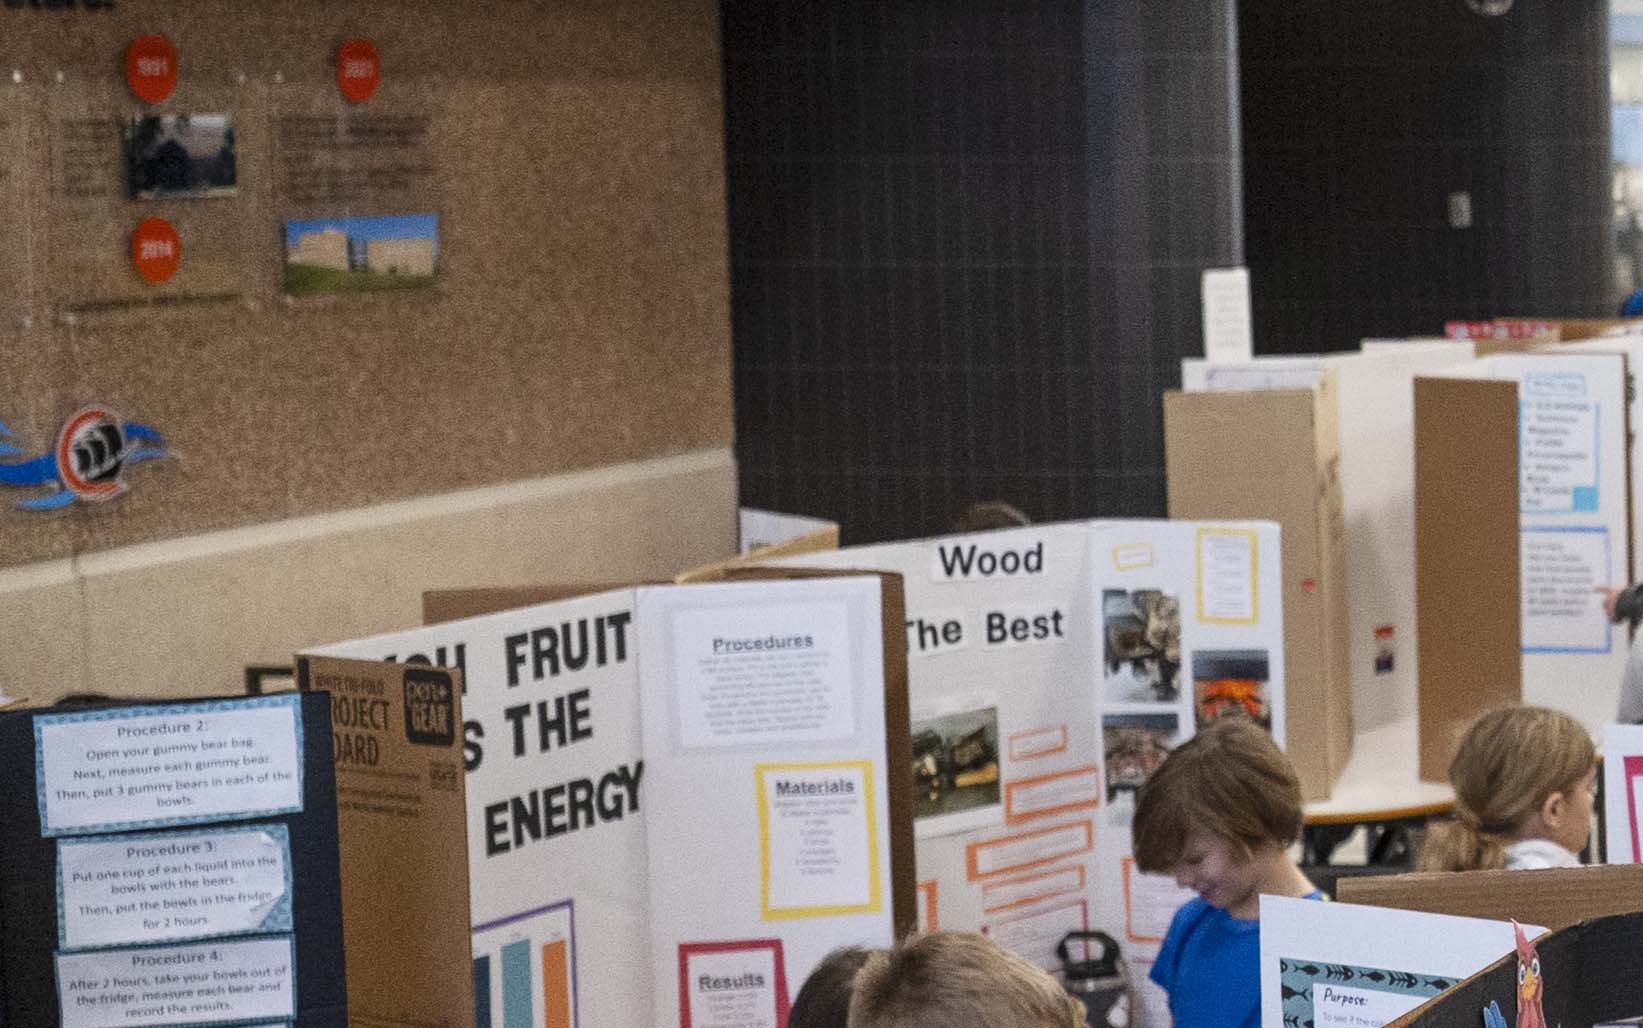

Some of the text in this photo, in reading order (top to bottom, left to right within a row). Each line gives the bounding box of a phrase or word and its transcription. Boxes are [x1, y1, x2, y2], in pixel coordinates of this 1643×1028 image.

[938, 542, 1044, 577] Wood
[986, 609, 1064, 644] Best
[505, 611, 631, 687] FRUIT
[712, 635, 813, 654] Procedures
[333, 698, 390, 732] ROJECT
[505, 689, 593, 758] THE
[775, 779, 854, 796] Materials
[484, 760, 643, 857] ENERGY
[698, 973, 765, 991] Results
